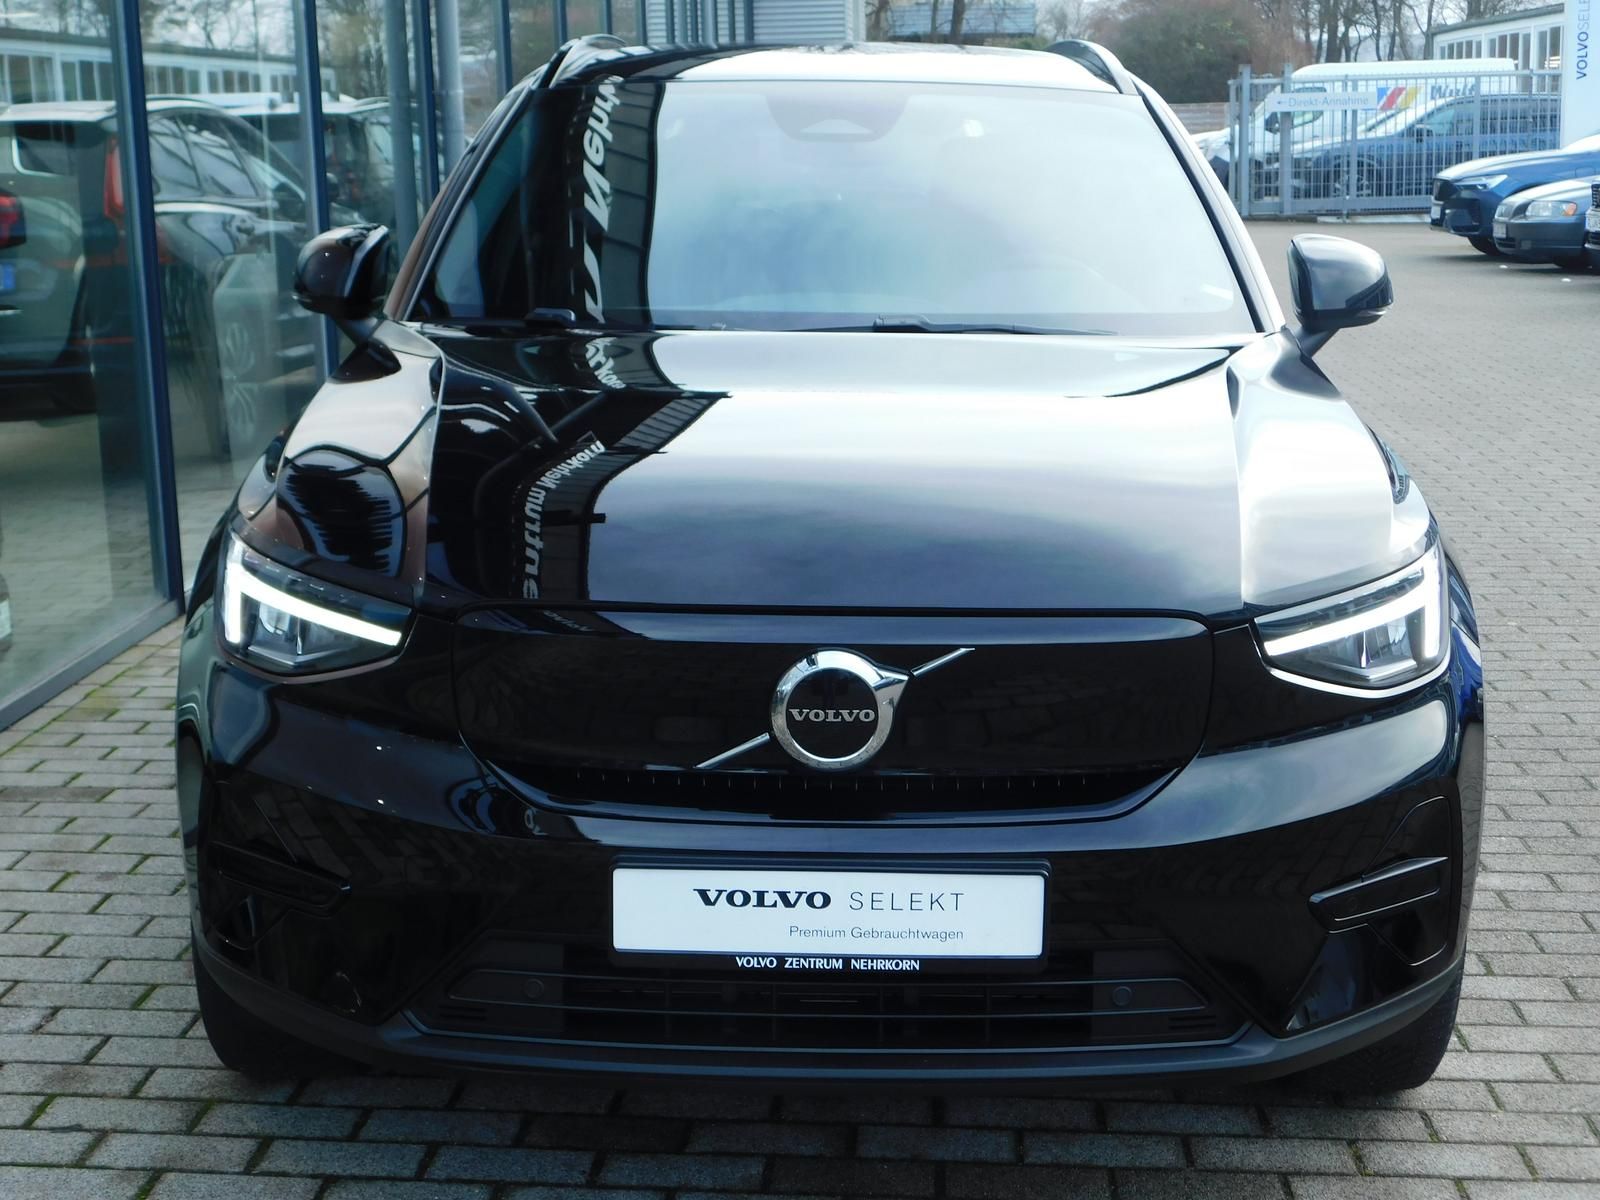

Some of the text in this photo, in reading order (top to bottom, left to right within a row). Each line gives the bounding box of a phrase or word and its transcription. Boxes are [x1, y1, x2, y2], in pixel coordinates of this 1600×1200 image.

[1576, 31, 1589, 80] VOLVO
[1288, 96, 1370, 107] Direkt-Annahme
[789, 708, 876, 722] VOLVO
[693, 888, 964, 911] VOLVO SELEKT
[789, 926, 964, 942] Premium Gebrauchtwagen
[735, 956, 920, 971] VOLVO ZENTRUM NEHRKORN
